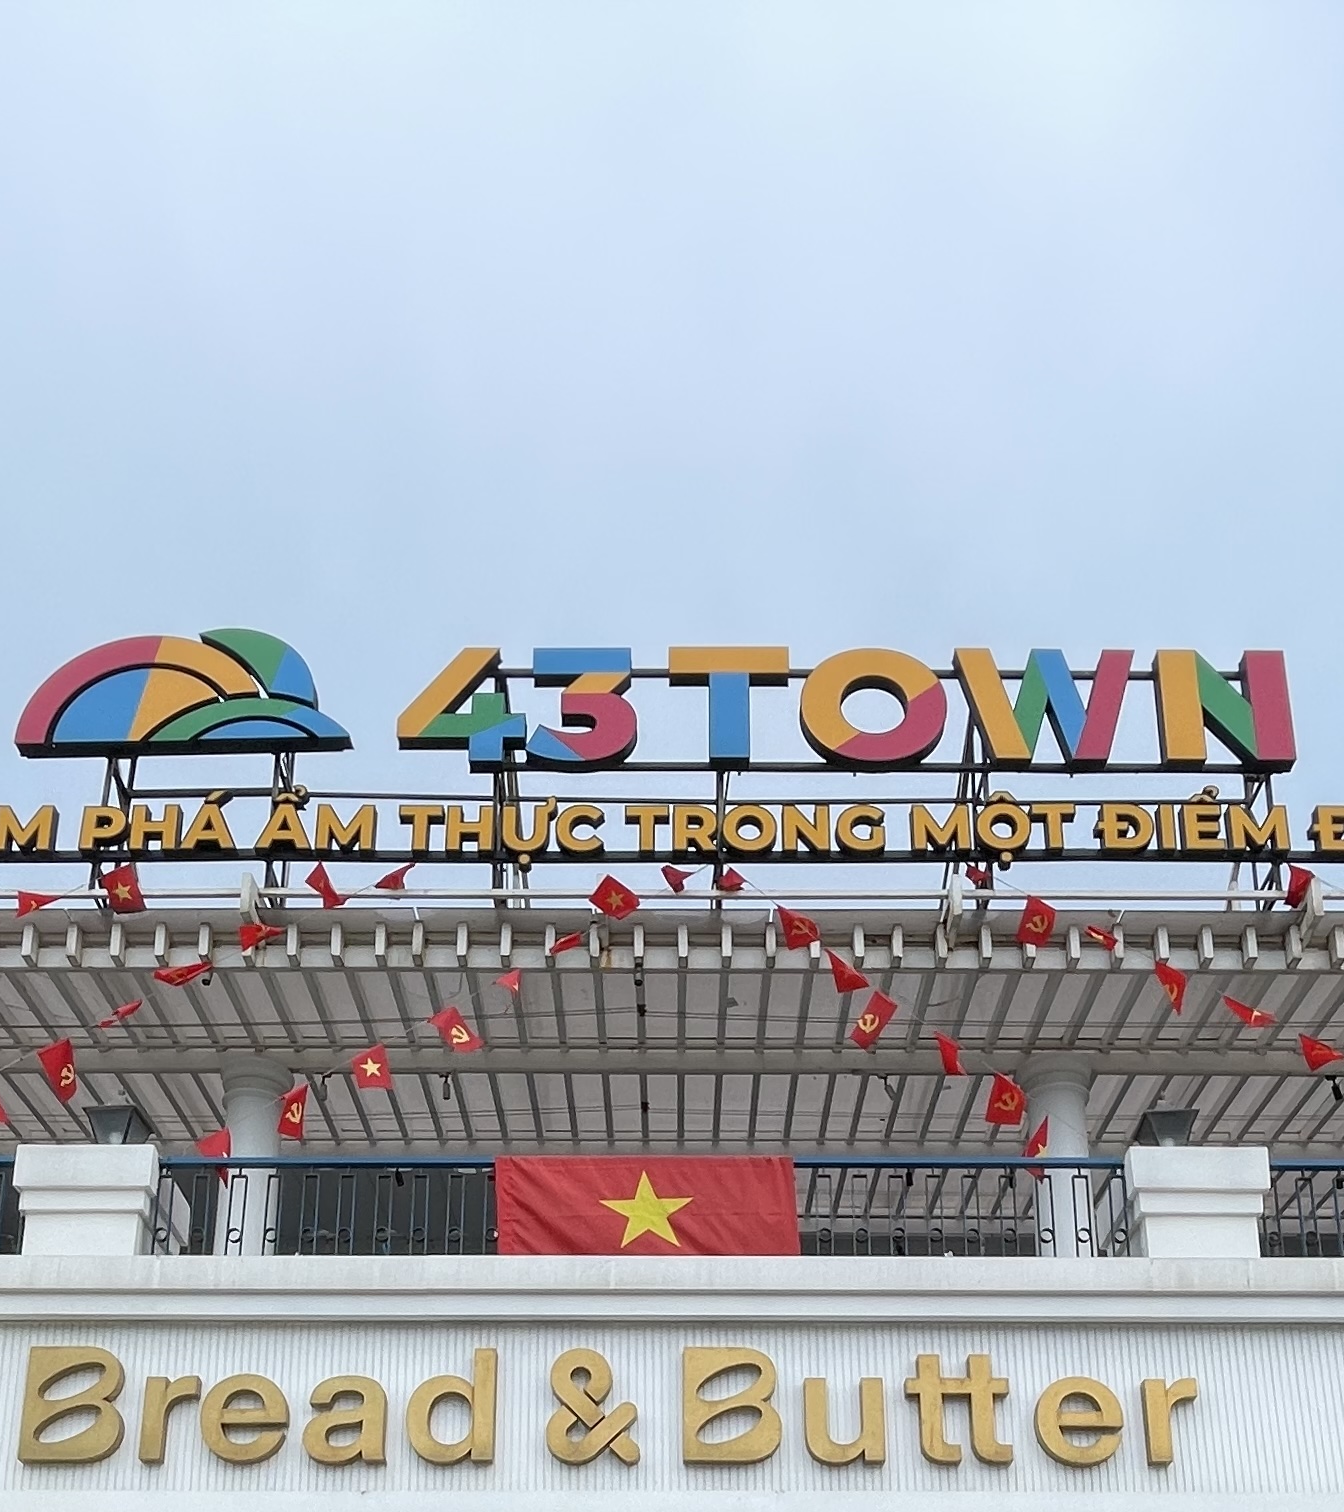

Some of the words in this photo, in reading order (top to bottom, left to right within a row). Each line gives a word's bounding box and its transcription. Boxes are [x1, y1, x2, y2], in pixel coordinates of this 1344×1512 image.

[79, 790, 239, 854] PHÁ
[256, 785, 389, 854] ẨM
[400, 798, 605, 871] THỰC
[625, 802, 885, 856] TRONG
[910, 790, 1076, 870] MỘT
[1094, 786, 1290, 855] ĐIỂM
[17, 1346, 498, 1466] Bread
[546, 1347, 640, 1466] &
[682, 1346, 1198, 1468] Butter
